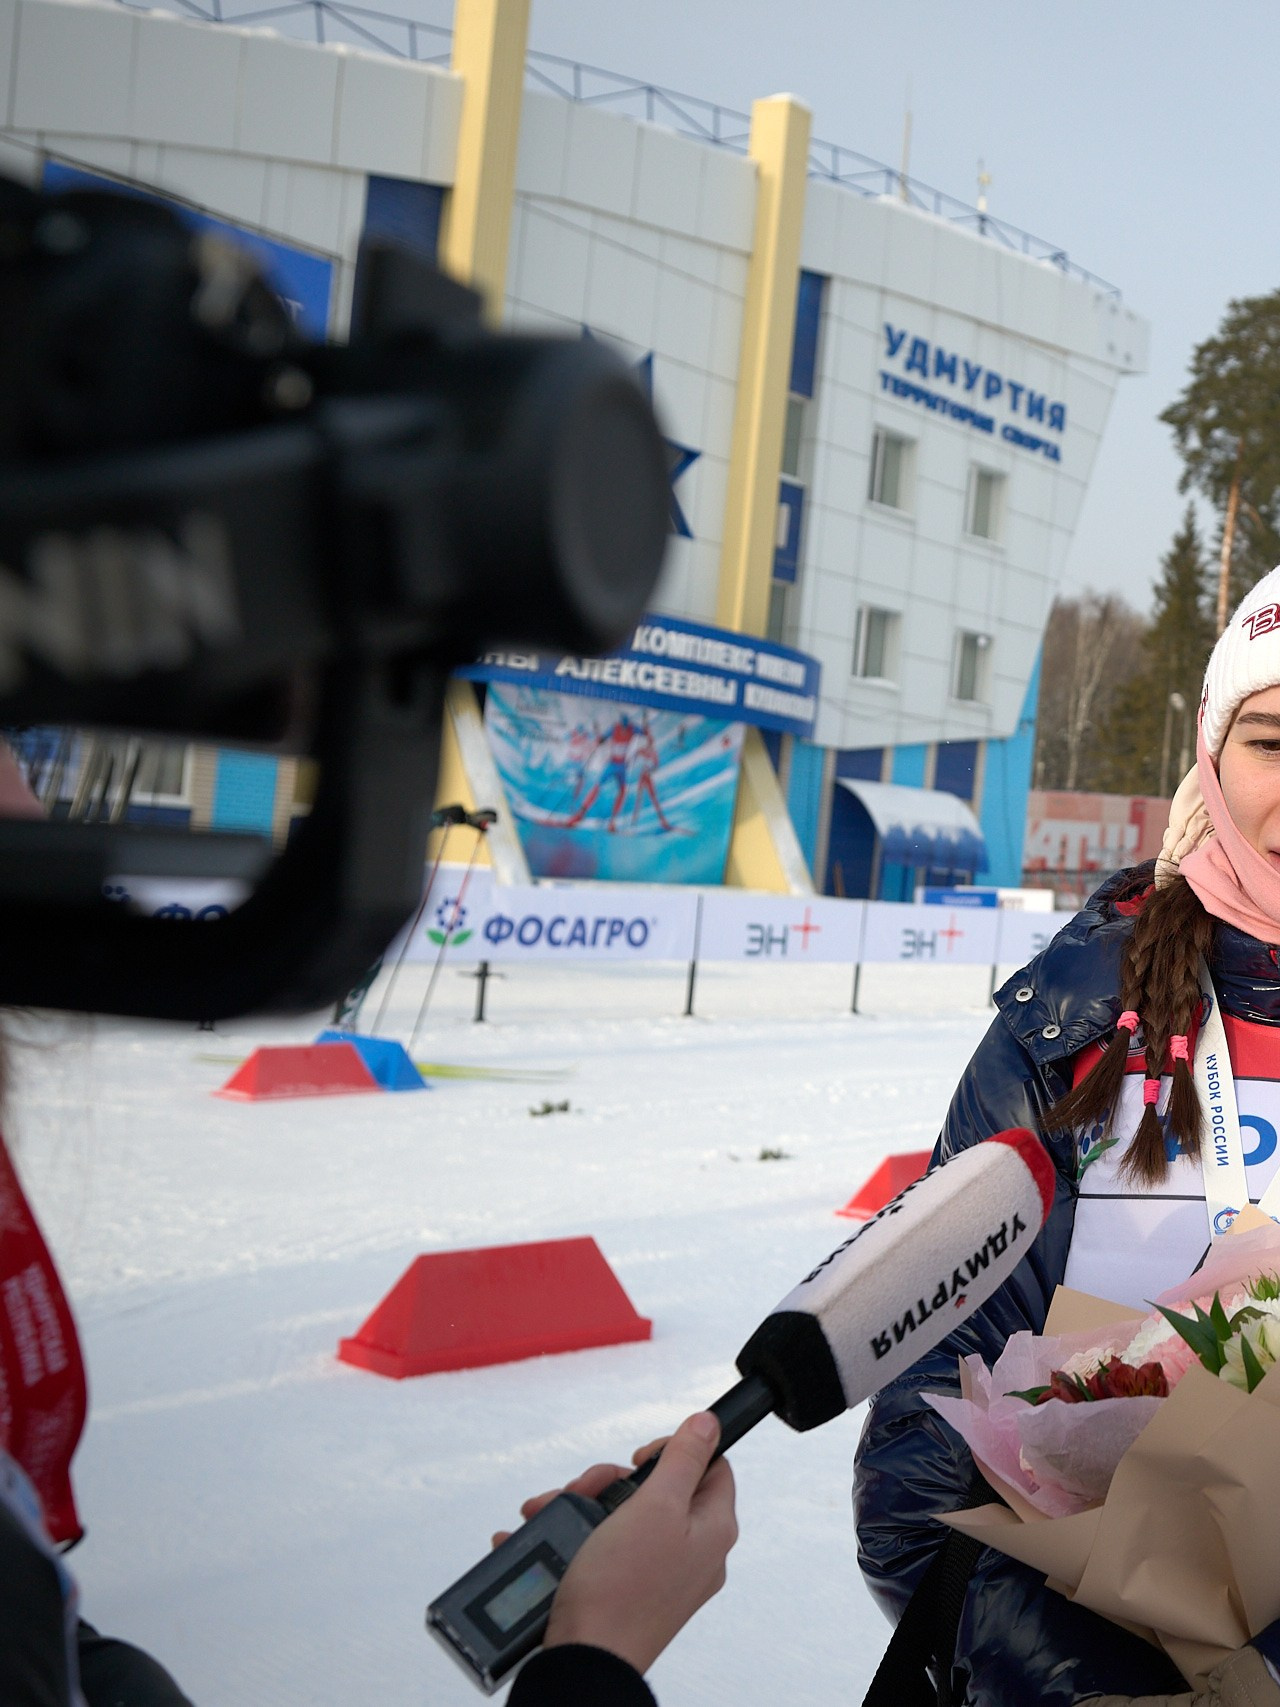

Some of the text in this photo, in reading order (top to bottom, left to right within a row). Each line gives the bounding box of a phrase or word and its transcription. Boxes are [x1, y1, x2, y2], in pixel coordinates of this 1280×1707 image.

[884, 321, 1066, 432] УДМУРТИЯ
[483, 914, 649, 948] ФОСАГРО
[1205, 1053, 1230, 1168] КУБОК РОССИИ
[868, 1211, 1028, 1362] УДМУРТИЯ
